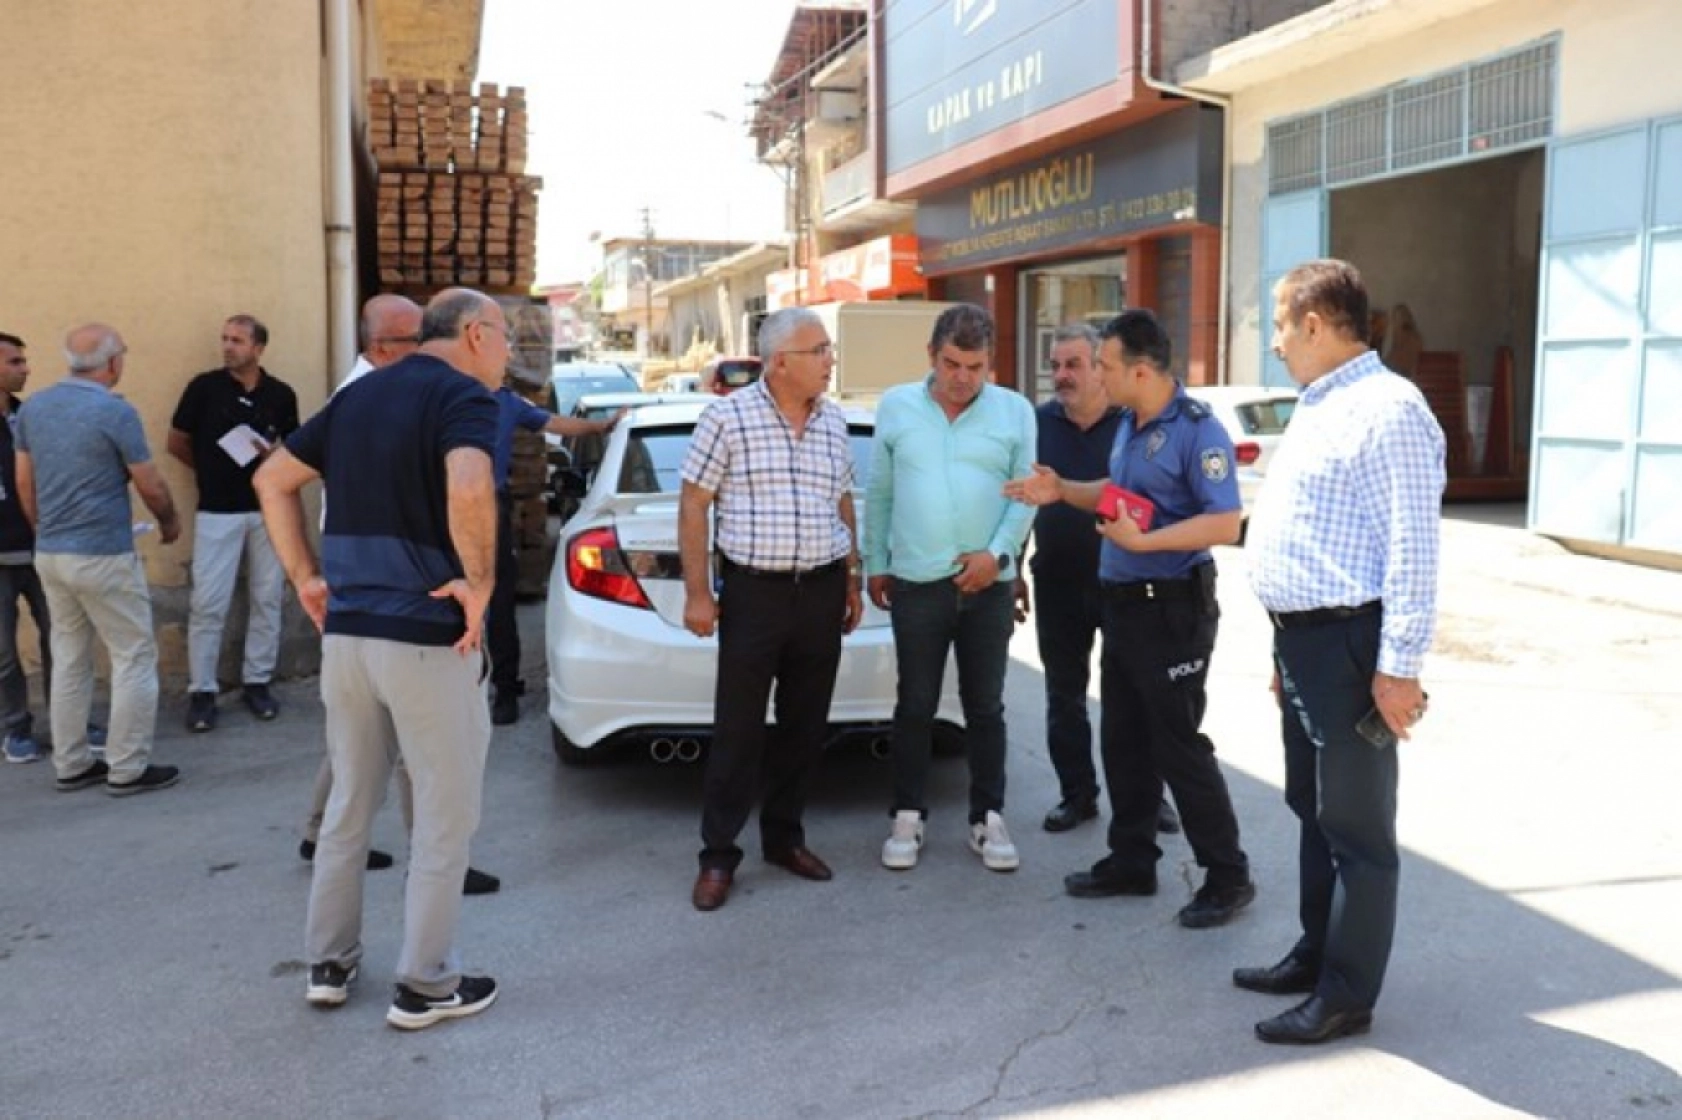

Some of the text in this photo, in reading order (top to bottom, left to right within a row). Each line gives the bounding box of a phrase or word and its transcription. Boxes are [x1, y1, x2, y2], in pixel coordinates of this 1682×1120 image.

[927, 49, 1042, 133] KAPAK ve KAPI
[969, 152, 1093, 230] MUTLUOĞLU
